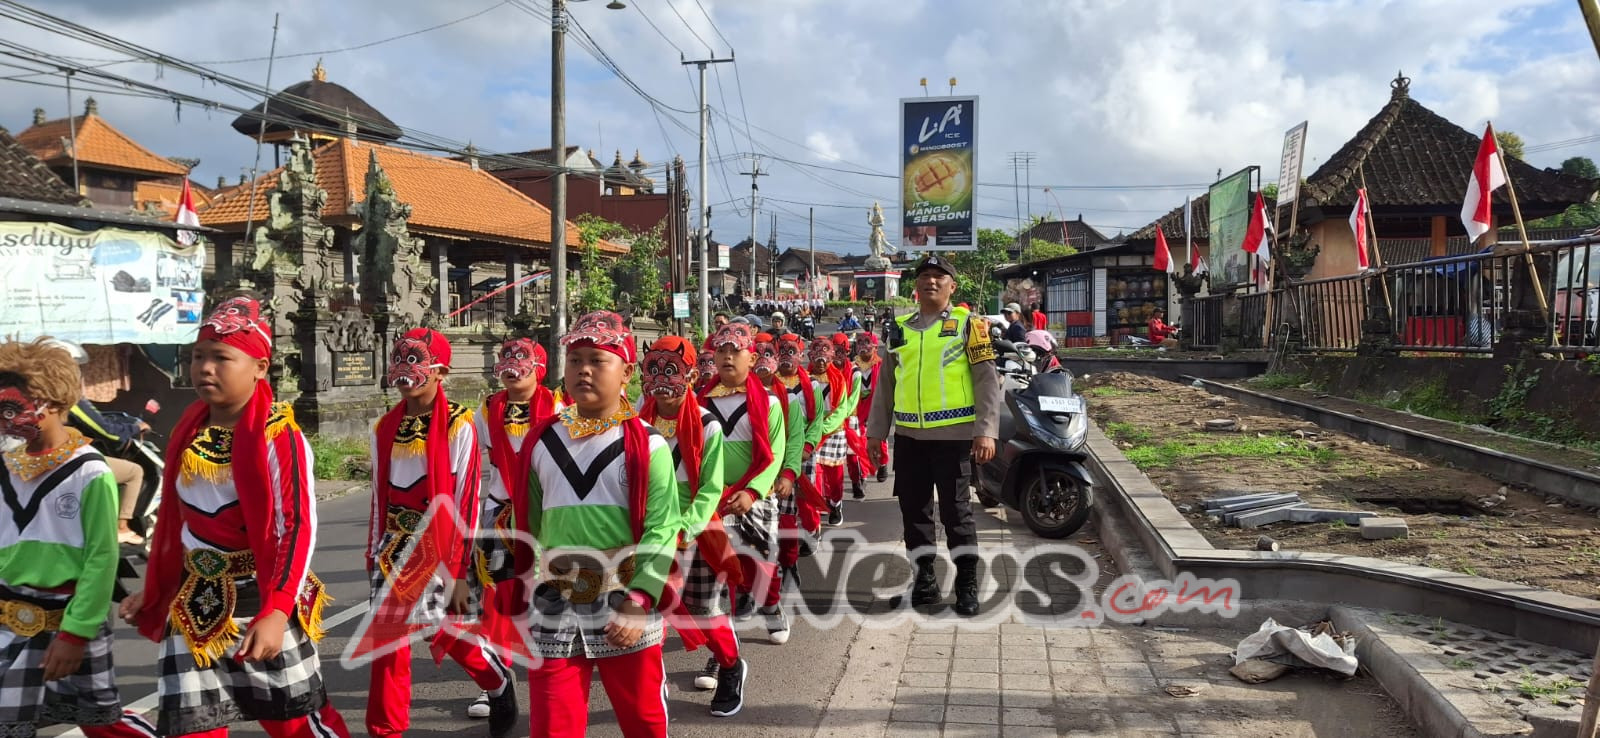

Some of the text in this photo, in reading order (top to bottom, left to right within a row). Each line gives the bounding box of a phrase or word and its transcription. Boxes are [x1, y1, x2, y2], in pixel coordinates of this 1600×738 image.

[906, 205, 950, 216] MANGO
[913, 210, 971, 224] SEASON!
[0, 227, 99, 255] sditya
